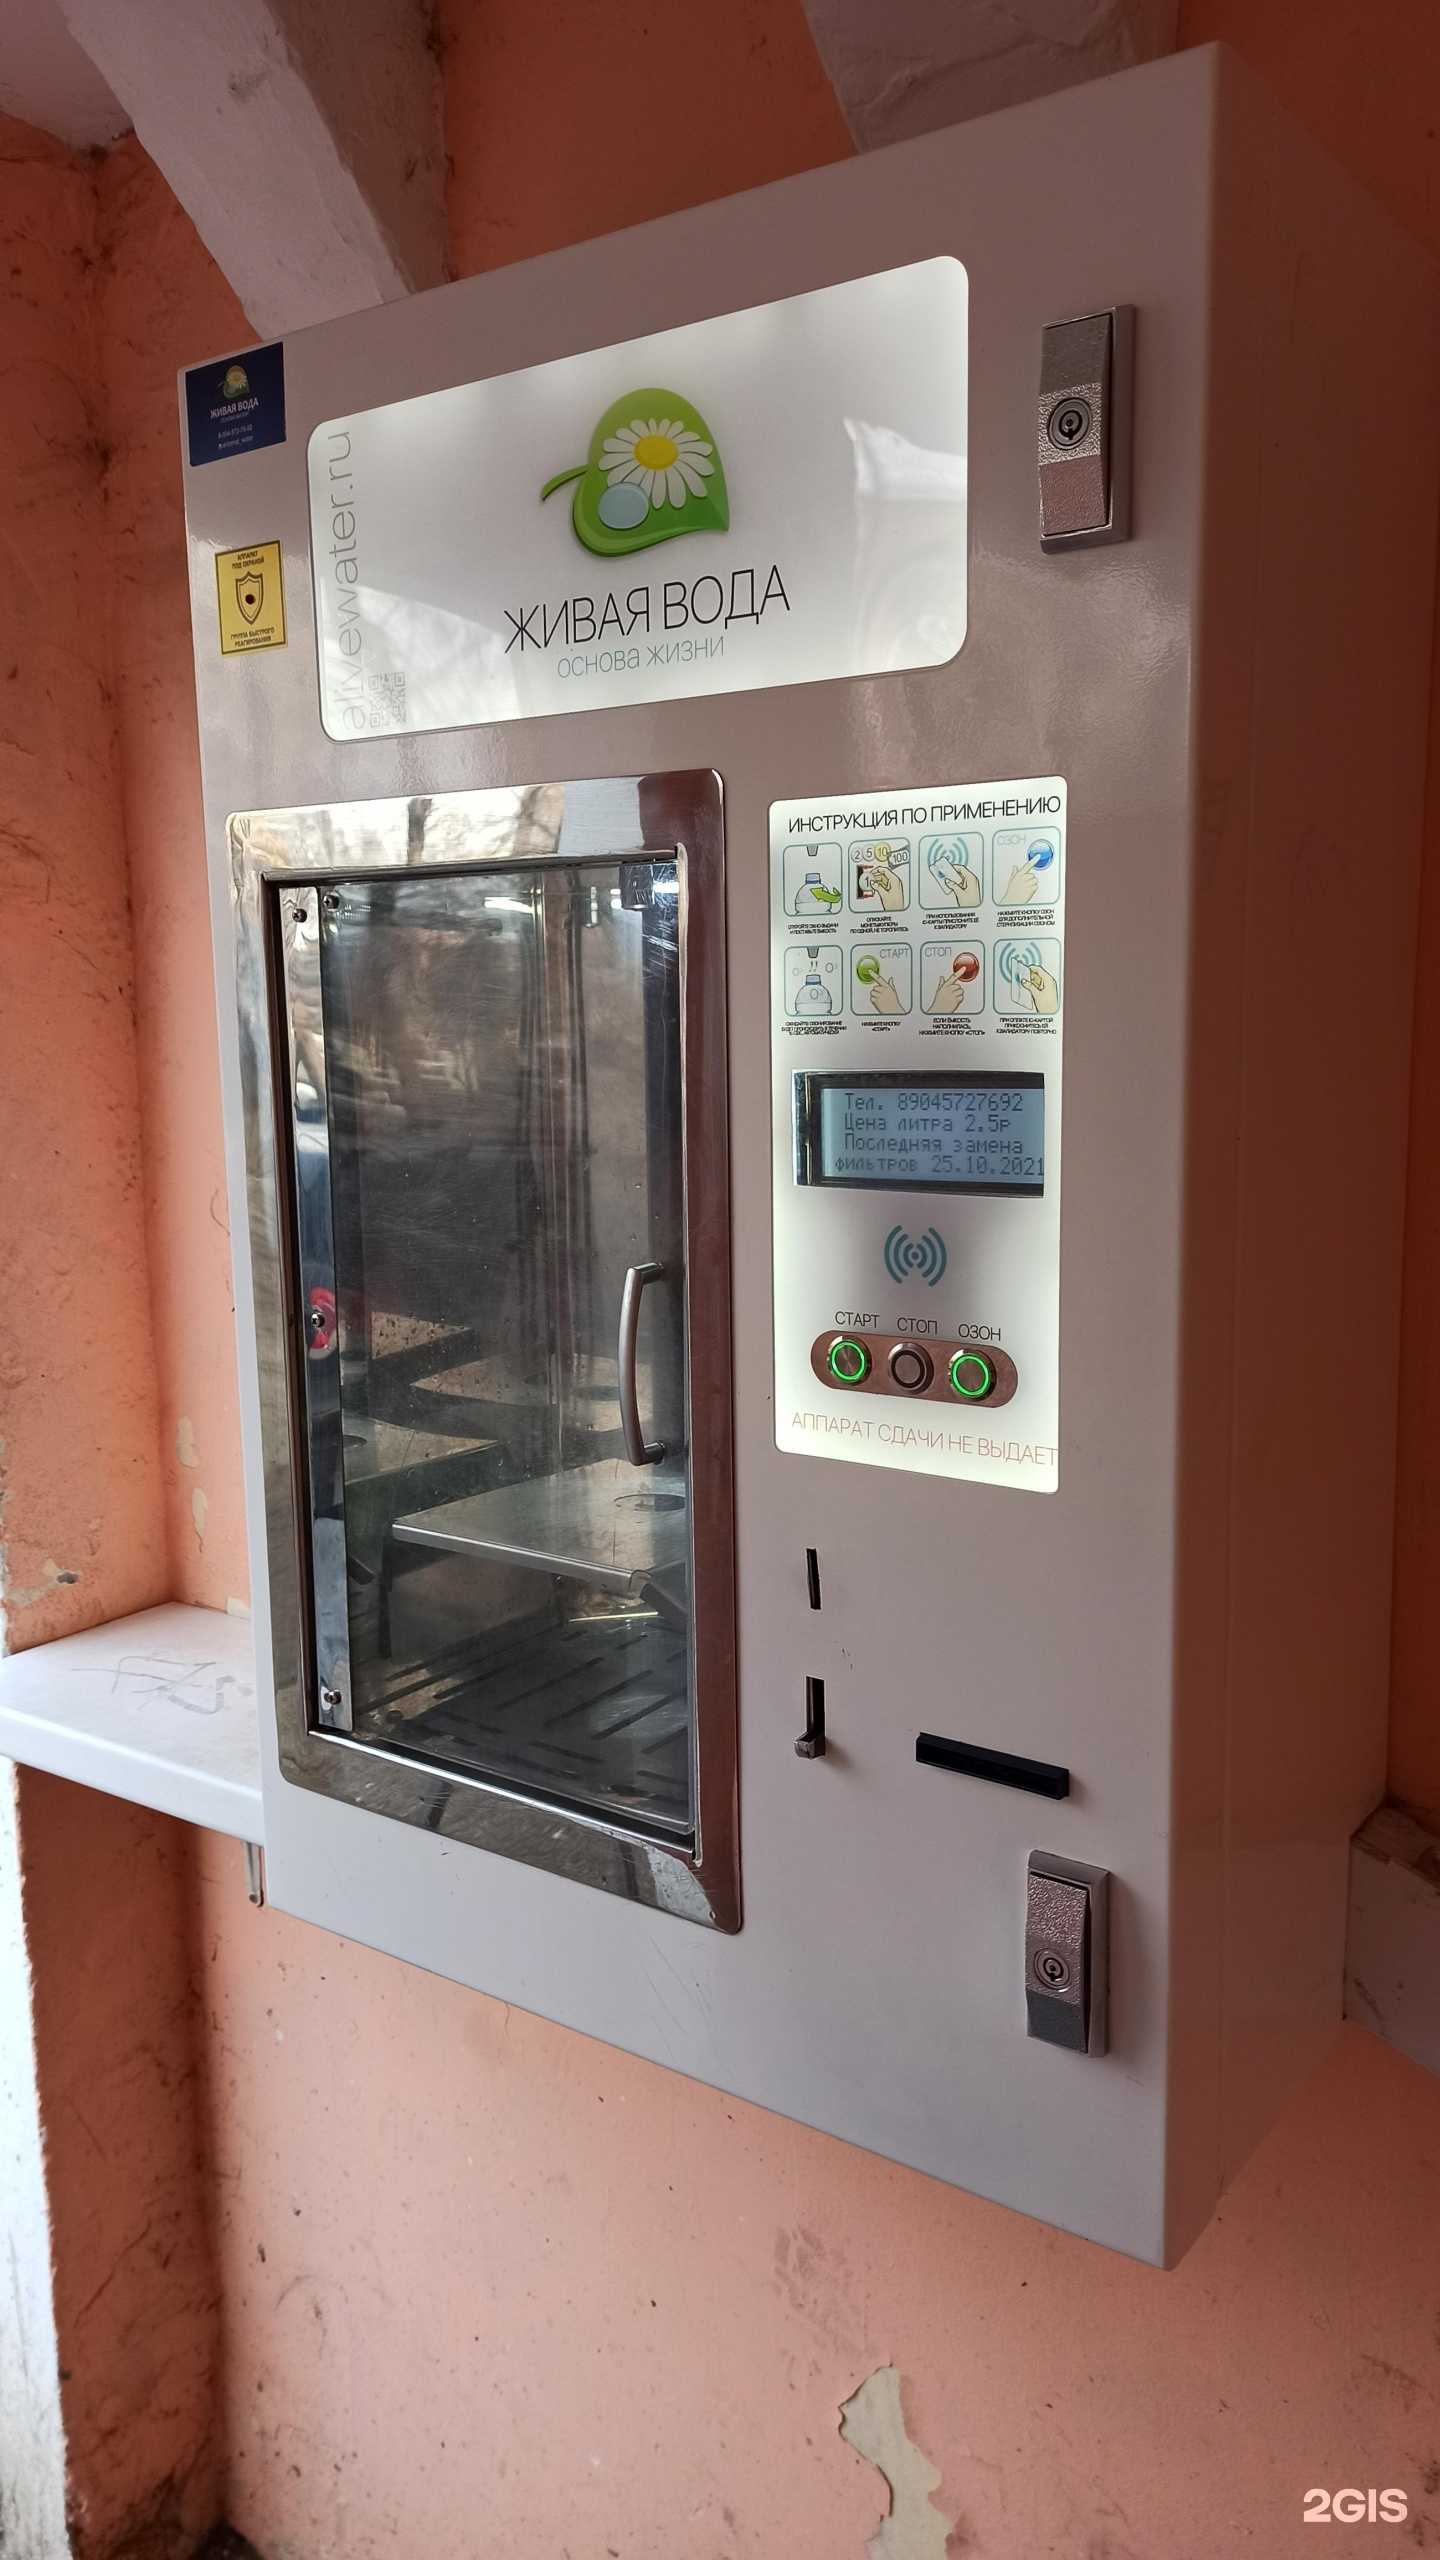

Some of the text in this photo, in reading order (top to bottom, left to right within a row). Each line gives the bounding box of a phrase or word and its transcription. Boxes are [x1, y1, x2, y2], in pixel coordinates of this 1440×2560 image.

[209, 403, 237, 419] ЖИВАЯ
[237, 397, 259, 411] ВОДА
[328, 431, 367, 731] alivewater.ru
[504, 565, 791, 653] ЖИВАЯ ВОДА
[788, 795, 1061, 833] ИНСТРУКЦИЯ ПО ПРИМЕНЕНИЮ
[877, 846, 888, 858] 10
[892, 850, 909, 864] 100
[879, 947, 910, 959] СТАРТ
[924, 946, 952, 958] СТОП
[844, 1093, 1024, 1112] Тел. 89045727692
[844, 1113, 887, 1132] Цена
[897, 1119, 953, 1132] литра
[844, 1133, 1024, 1155] Последняя замена
[835, 1155, 1045, 1176] фильтров 25.10.2021
[835, 1311, 1001, 1341] СТАРТ СТОП ОЗОН
[792, 1412, 1060, 1465] АППАРАТ СДАЧИ НЕ ВЫДАЕТ
